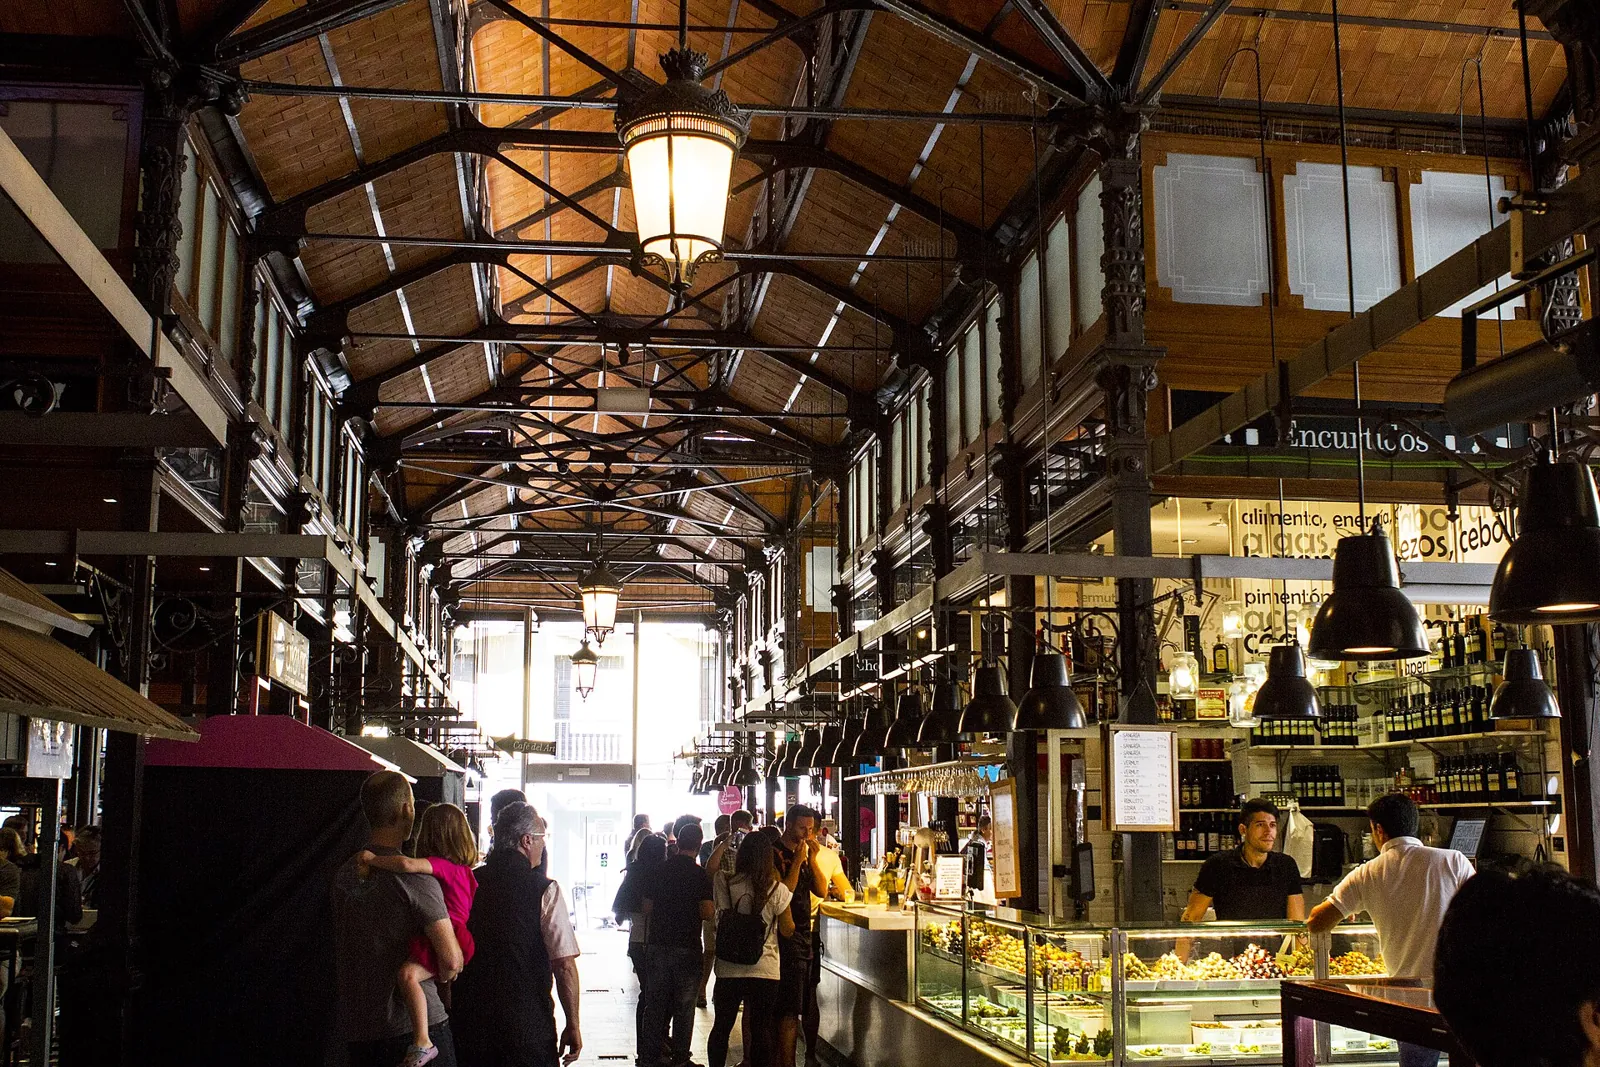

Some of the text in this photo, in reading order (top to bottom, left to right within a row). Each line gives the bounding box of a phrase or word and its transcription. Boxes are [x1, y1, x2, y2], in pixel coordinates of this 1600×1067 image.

[1242, 508, 1327, 528] alimento,
[1333, 509, 1392, 528] enería,
[531, 741, 543, 752] del
